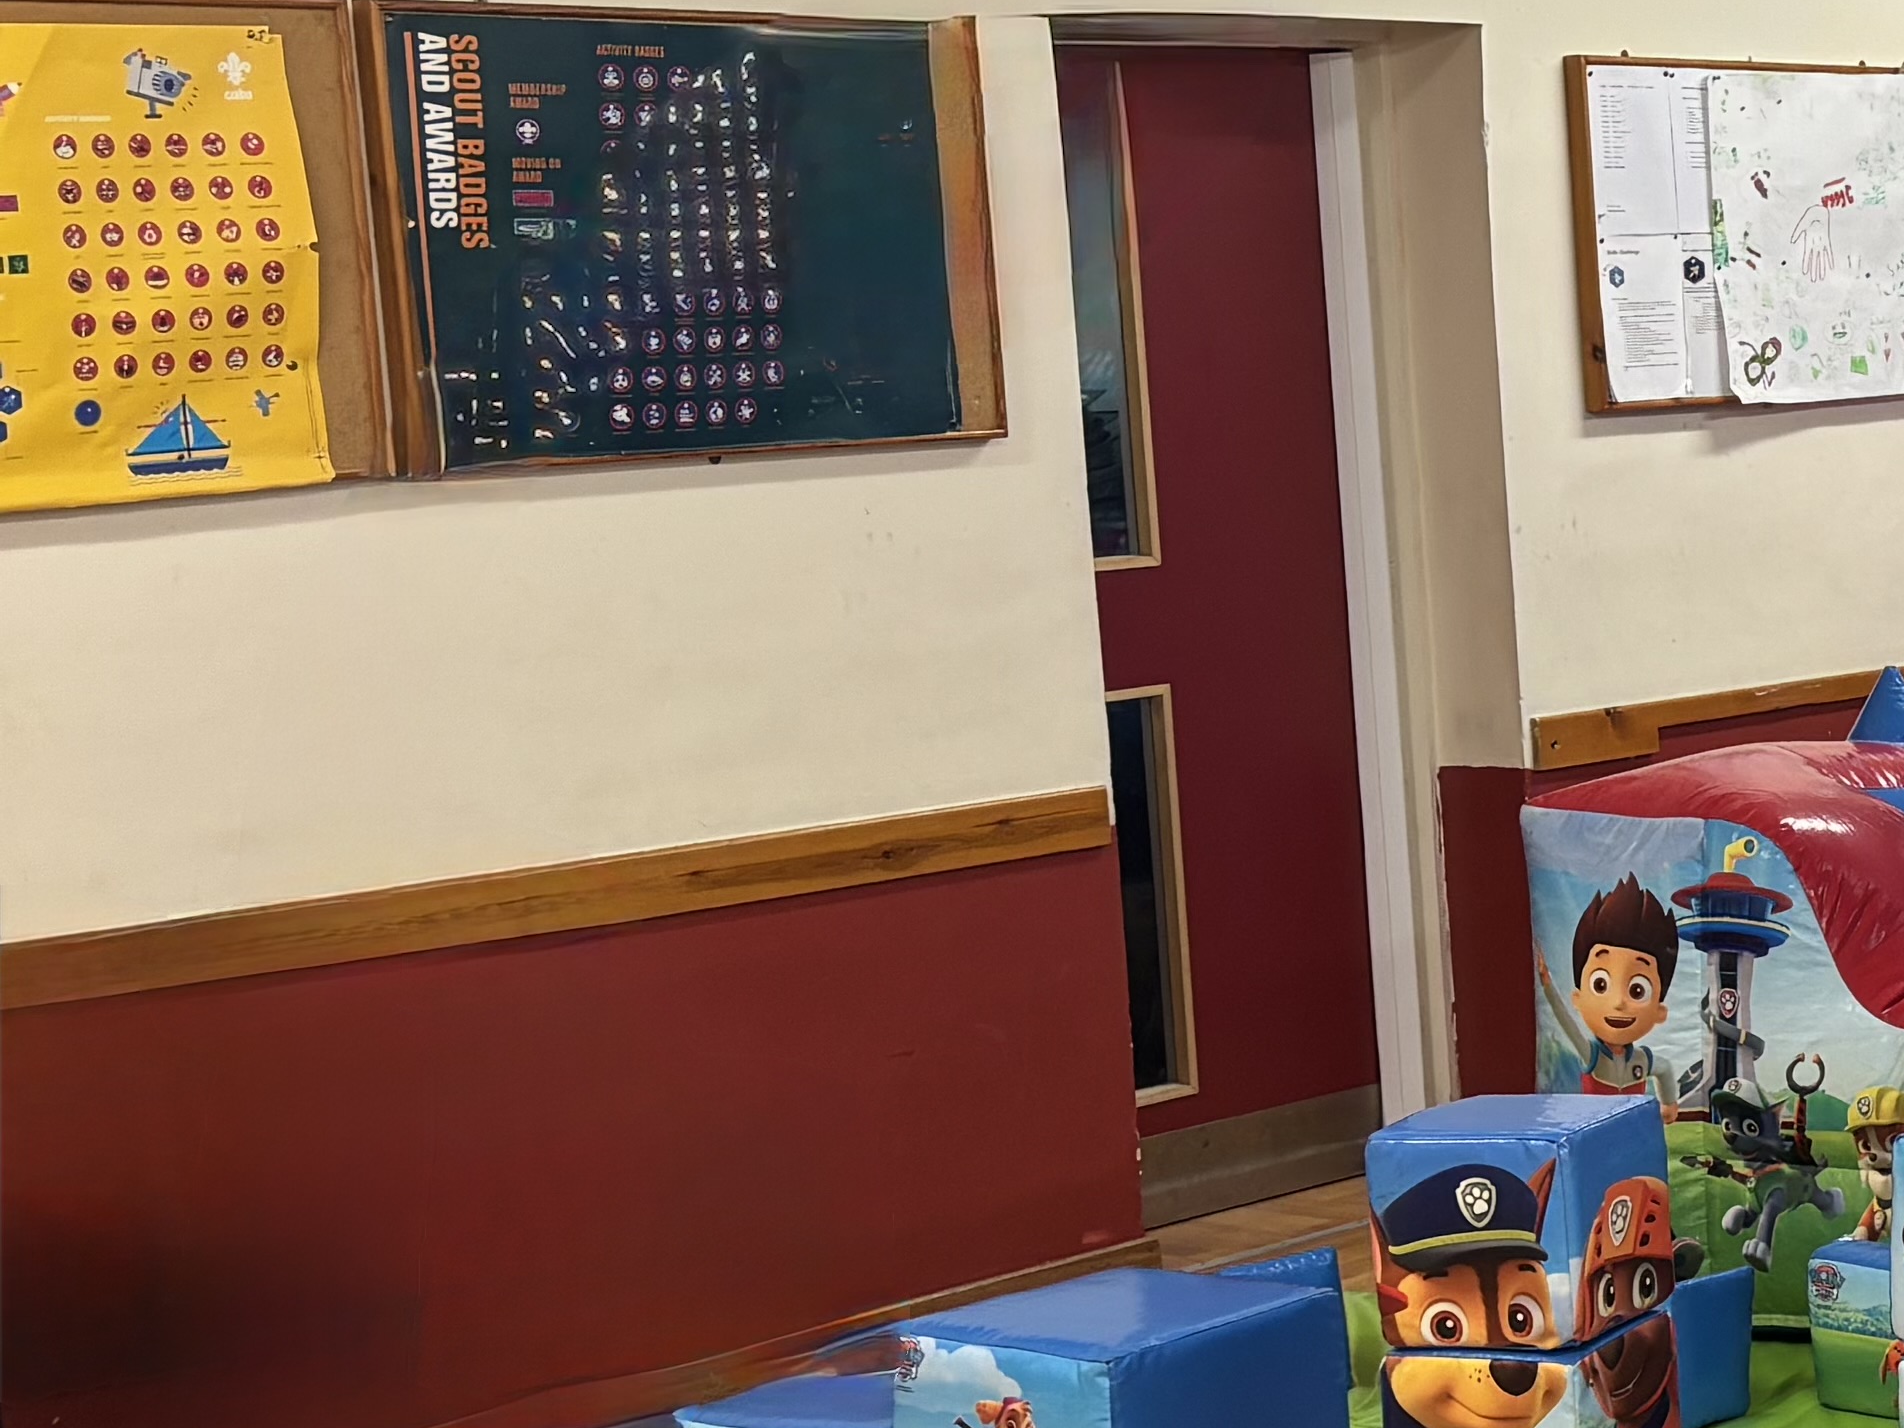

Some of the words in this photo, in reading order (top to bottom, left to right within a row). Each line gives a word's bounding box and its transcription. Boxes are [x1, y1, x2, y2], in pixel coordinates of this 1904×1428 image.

[417, 31, 450, 93] AND
[449, 34, 484, 129] SCOUT
[423, 102, 459, 229] AWARDS
[457, 139, 490, 249] BADGES
